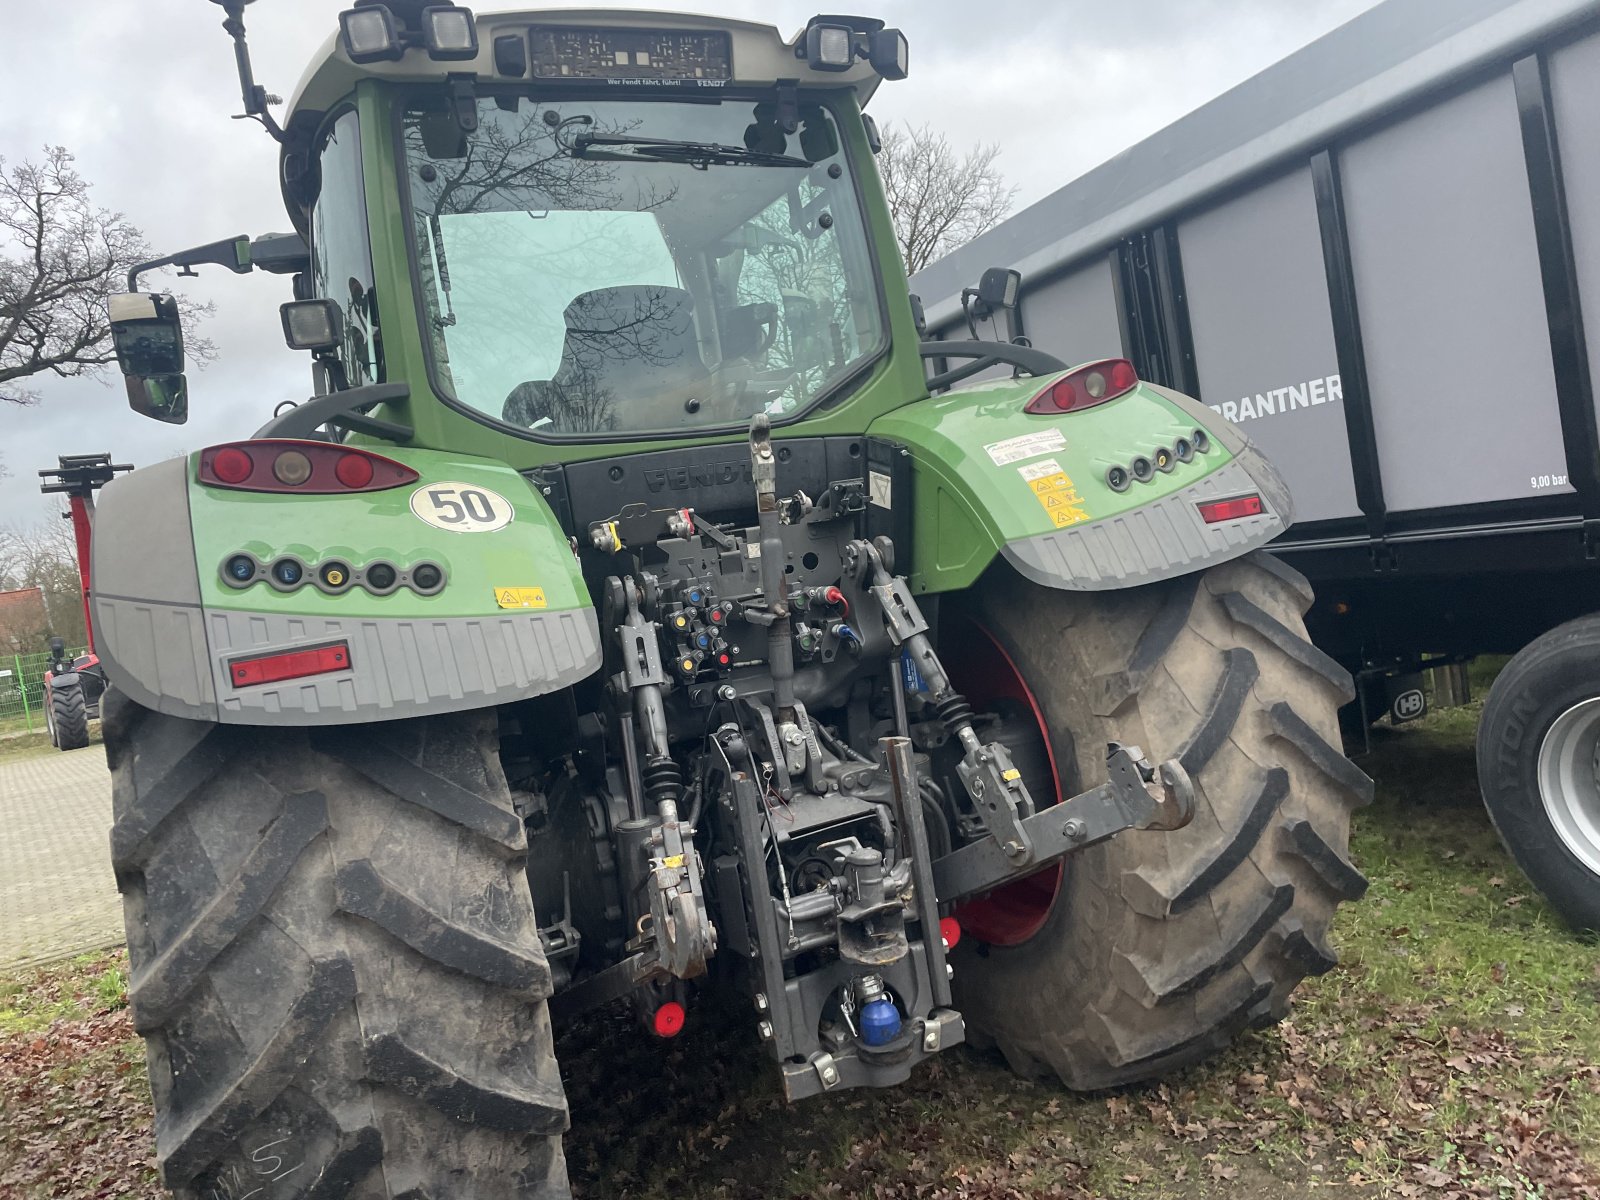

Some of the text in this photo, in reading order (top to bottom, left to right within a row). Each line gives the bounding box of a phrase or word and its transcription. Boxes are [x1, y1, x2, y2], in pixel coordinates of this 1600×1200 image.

[1209, 375, 1343, 424] RANTNER
[1530, 474, 1567, 490] 9,00 bar
[428, 489, 496, 523] 50
